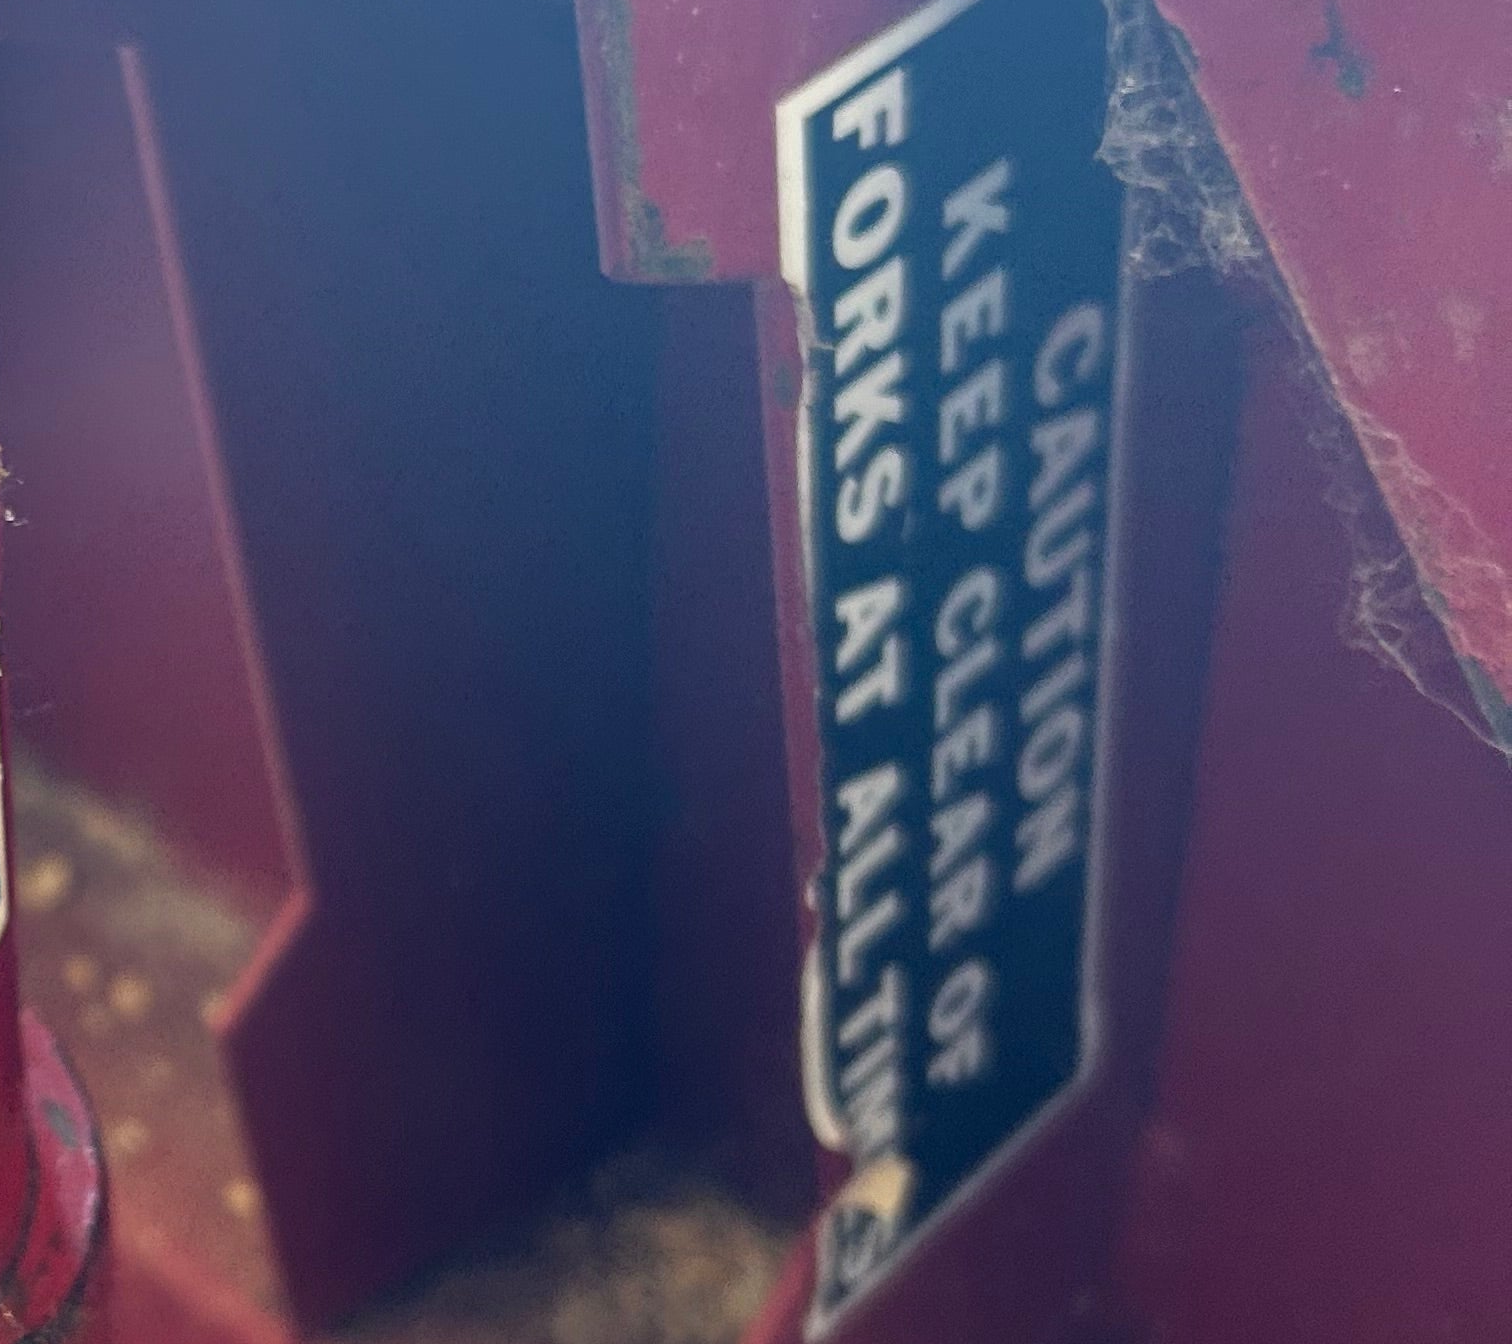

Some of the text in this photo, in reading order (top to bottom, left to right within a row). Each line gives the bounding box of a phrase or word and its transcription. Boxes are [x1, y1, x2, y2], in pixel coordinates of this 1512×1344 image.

[831, 66, 905, 545] FORKS
[835, 576, 903, 725] AT
[927, 156, 1012, 1086] KEEP CLEAR OF
[1014, 304, 1104, 896] CAUTION
[837, 762, 901, 986] ALL
